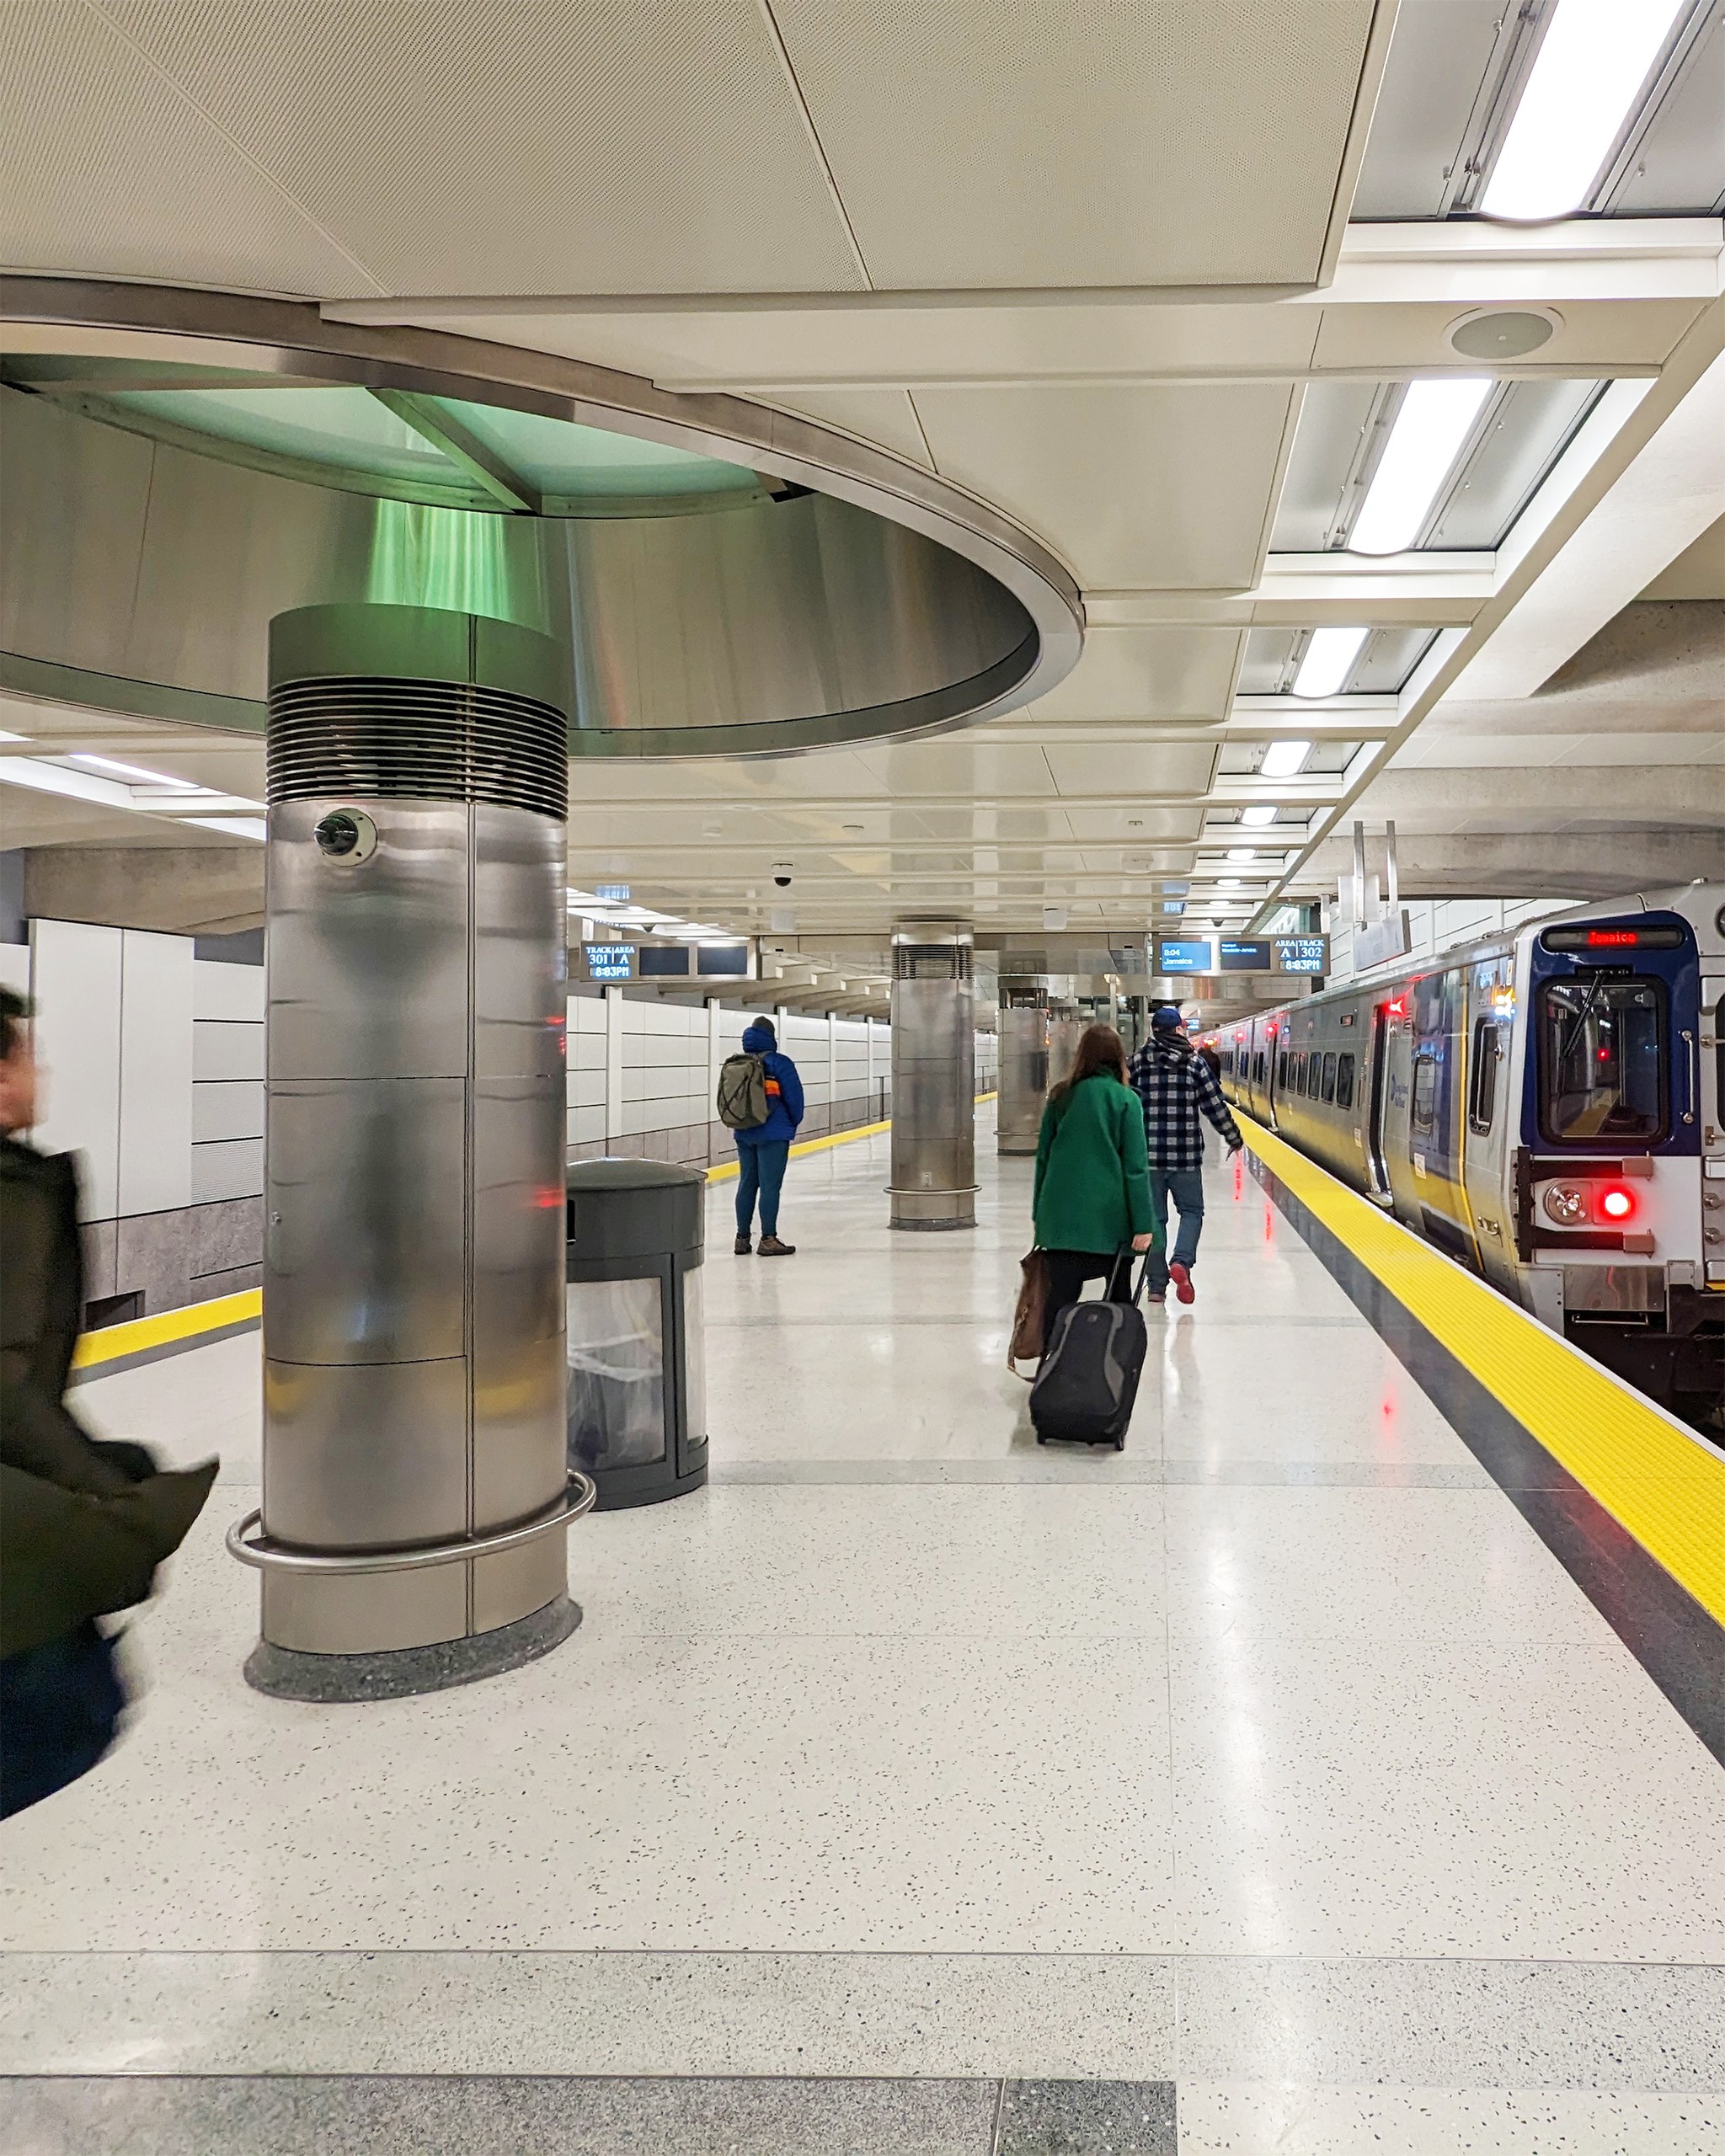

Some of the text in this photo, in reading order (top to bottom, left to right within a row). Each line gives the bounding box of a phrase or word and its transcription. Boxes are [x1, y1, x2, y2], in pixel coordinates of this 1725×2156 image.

[1589, 931, 1636, 943] Jamaica
[1280, 947, 1322, 958] A 302
[590, 954, 629, 964] 301 A
